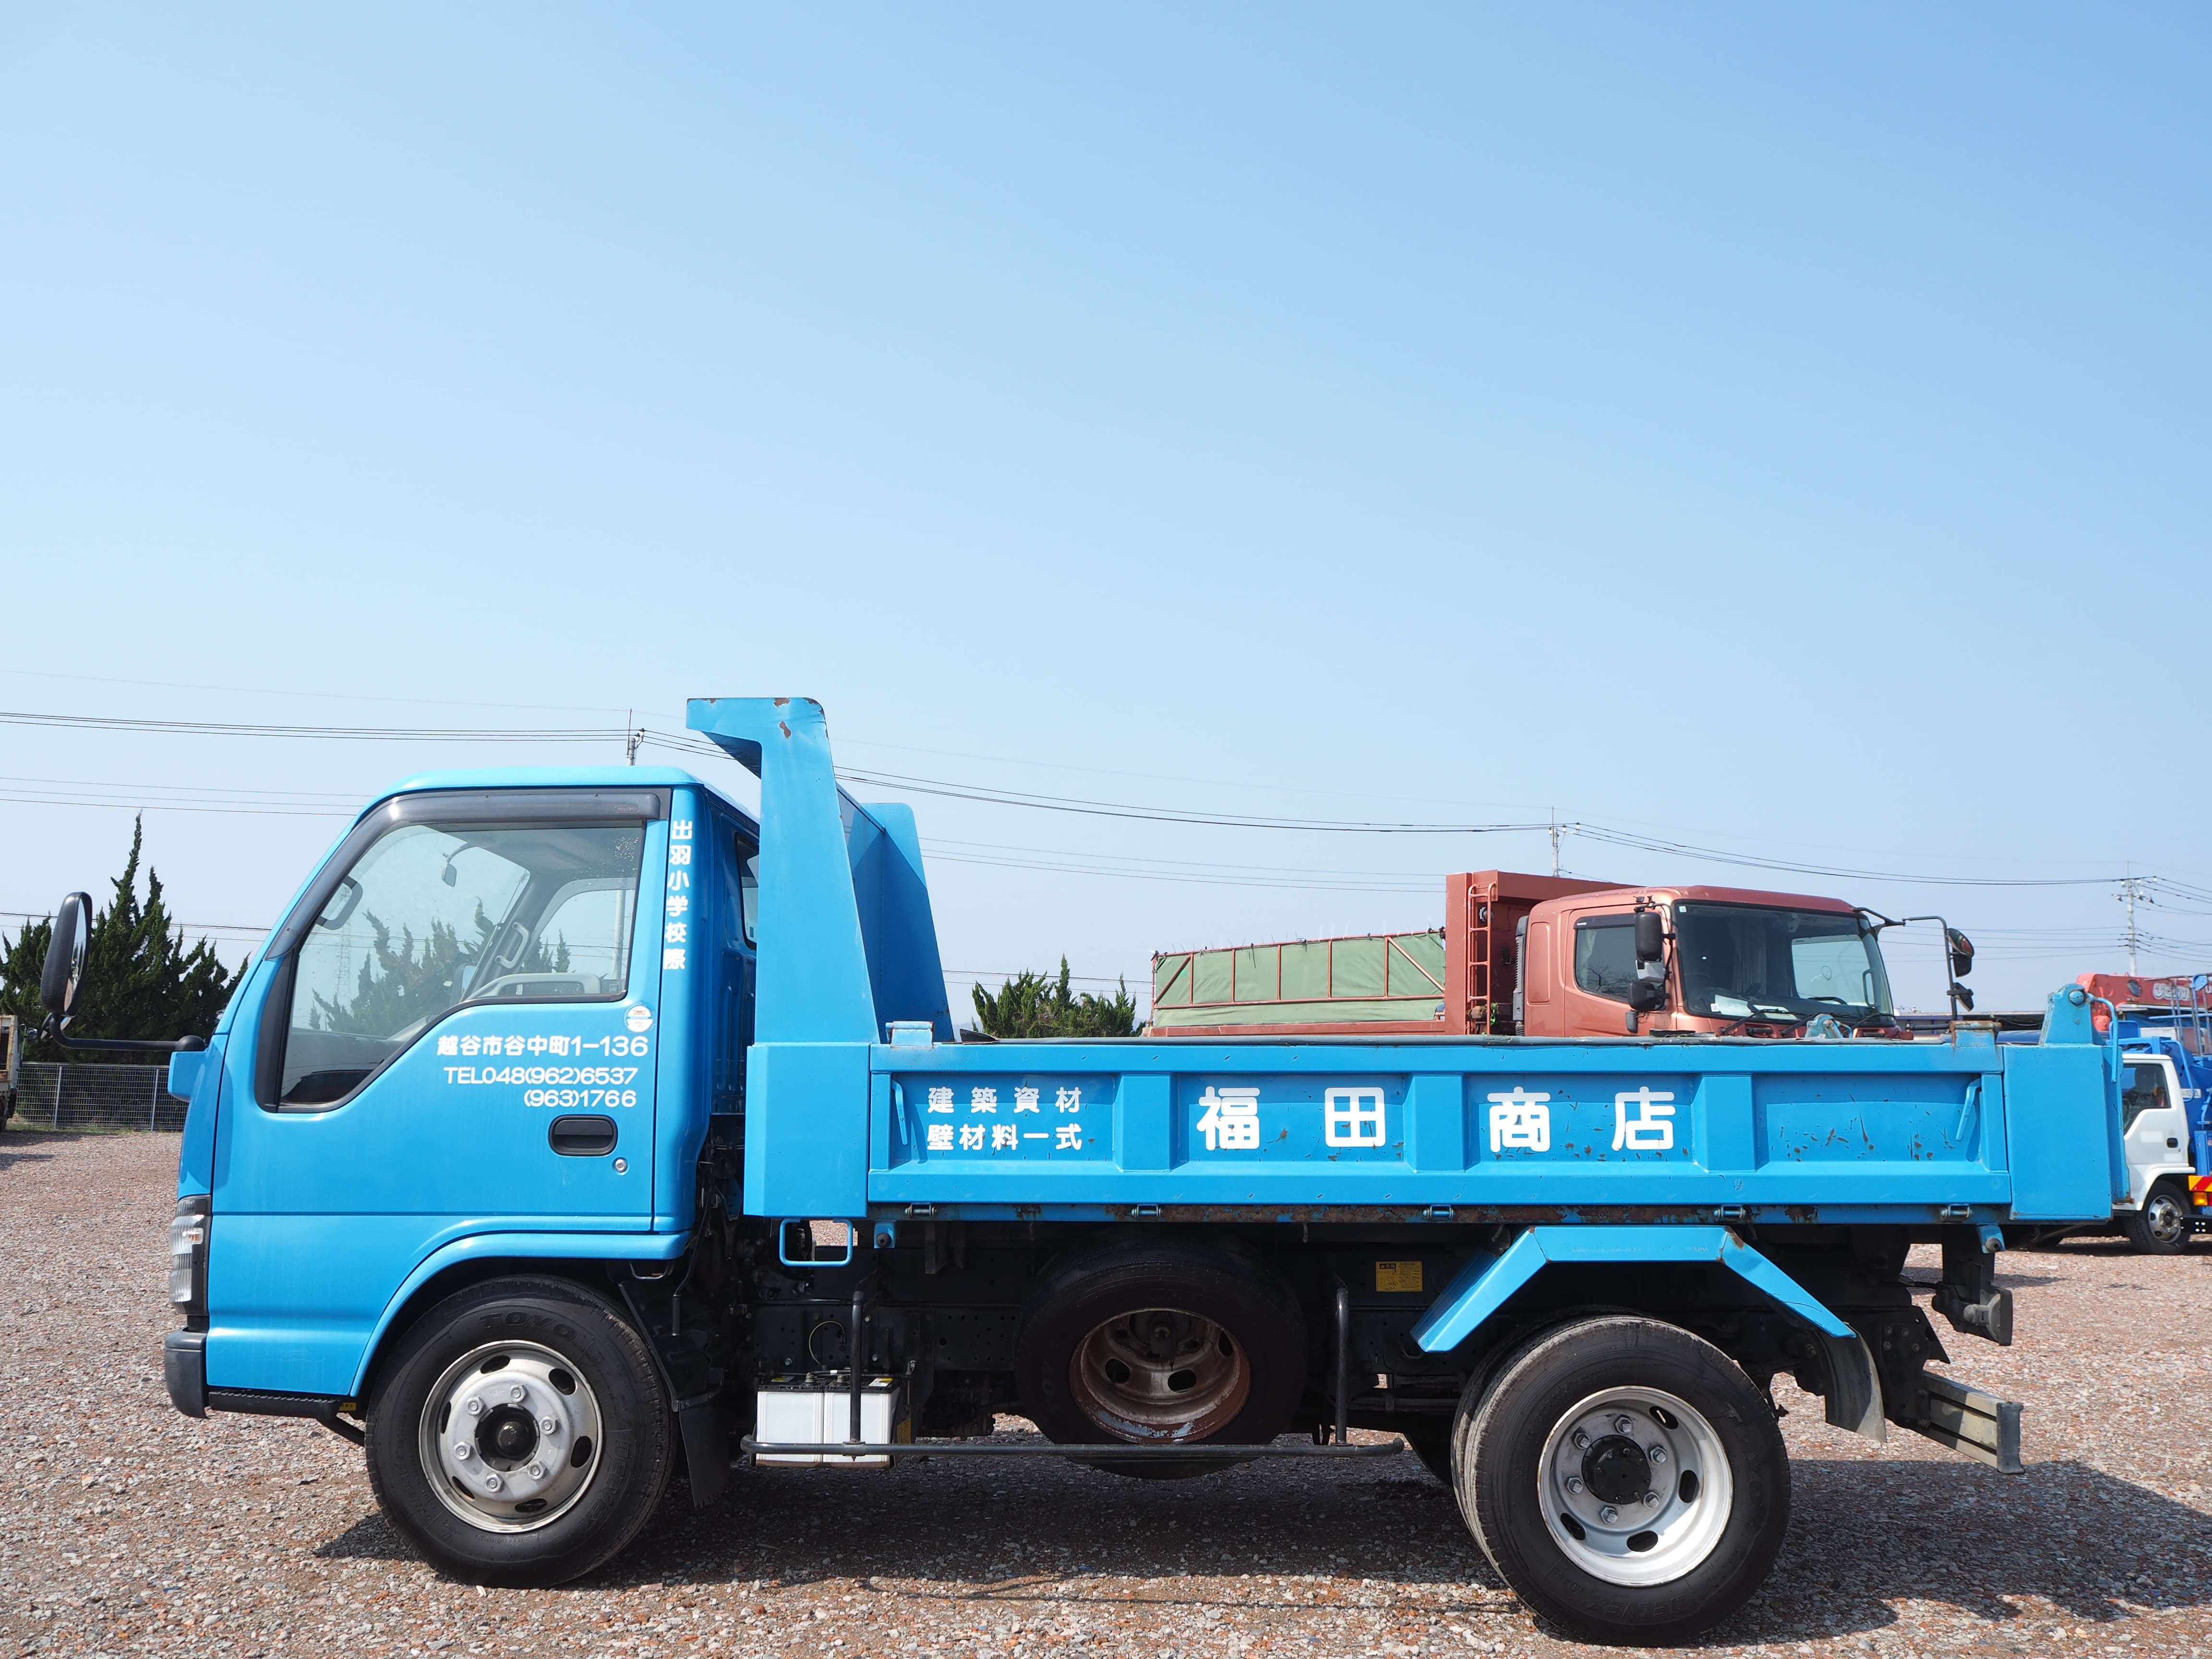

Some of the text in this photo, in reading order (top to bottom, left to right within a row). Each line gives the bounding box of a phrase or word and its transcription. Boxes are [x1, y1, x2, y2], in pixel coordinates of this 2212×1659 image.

[662, 819, 692, 970] 出羽小学校際
[443, 1067, 638, 1085] TEL048(962)6537
[524, 1089, 637, 1107] (963)1766
[927, 1087, 1082, 1113] 建築資材
[1196, 1086, 1676, 1153] 福田商店
[927, 1123, 1082, 1150] 壁材料一式
[479, 1311, 577, 1340] TOYO
